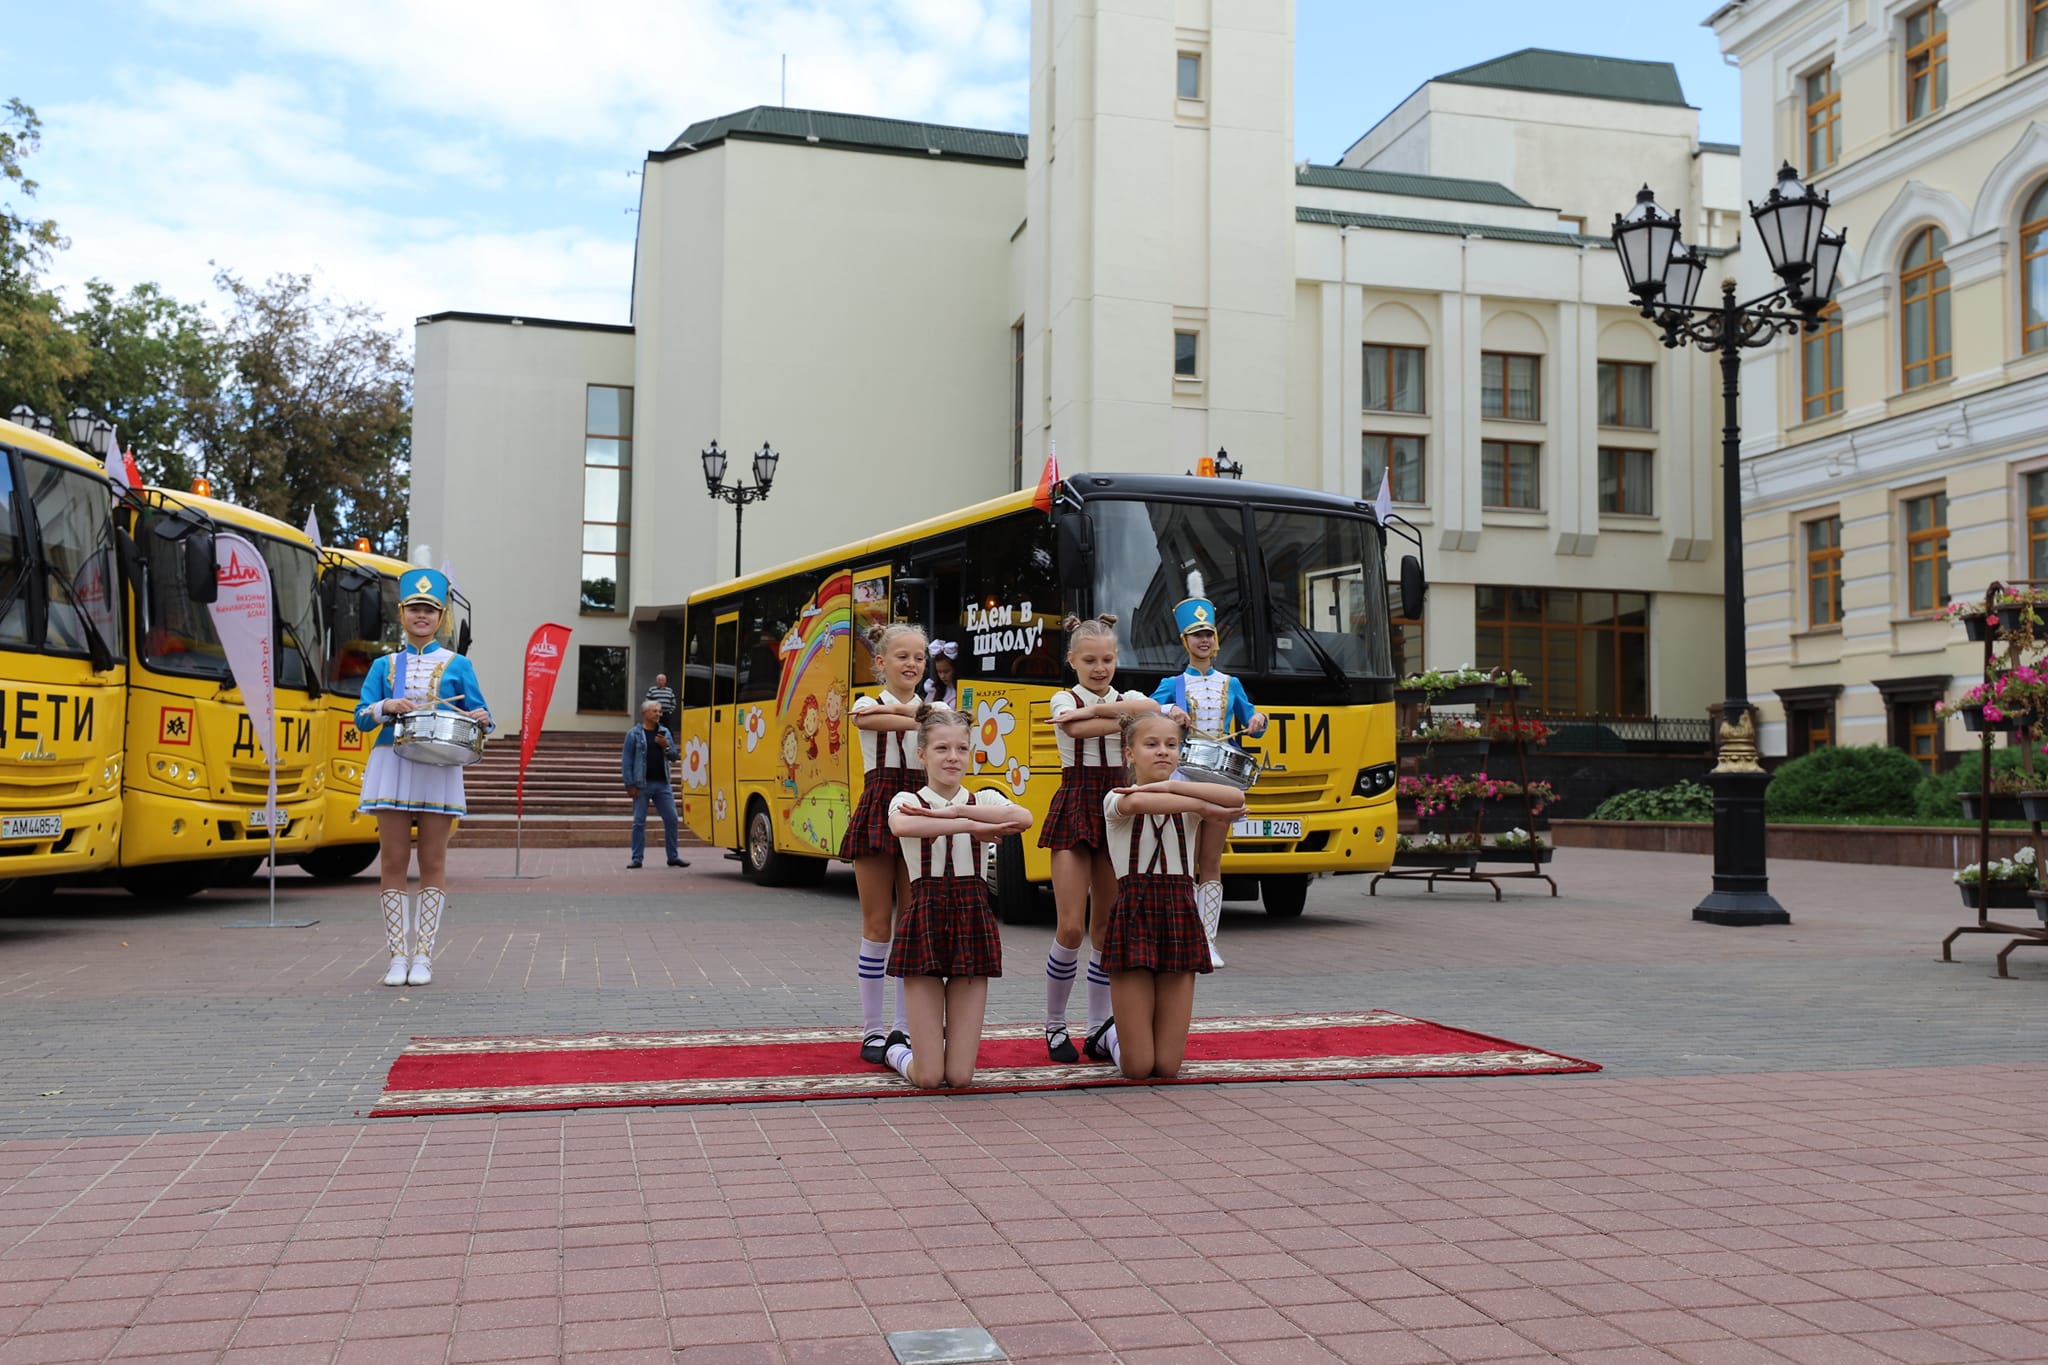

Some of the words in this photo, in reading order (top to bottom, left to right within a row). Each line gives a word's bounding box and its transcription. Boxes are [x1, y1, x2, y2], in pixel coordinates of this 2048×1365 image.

[0, 690, 94, 749] ЕТИ
[233, 714, 310, 758] ДТИ
[1273, 822, 1300, 835] 2478
